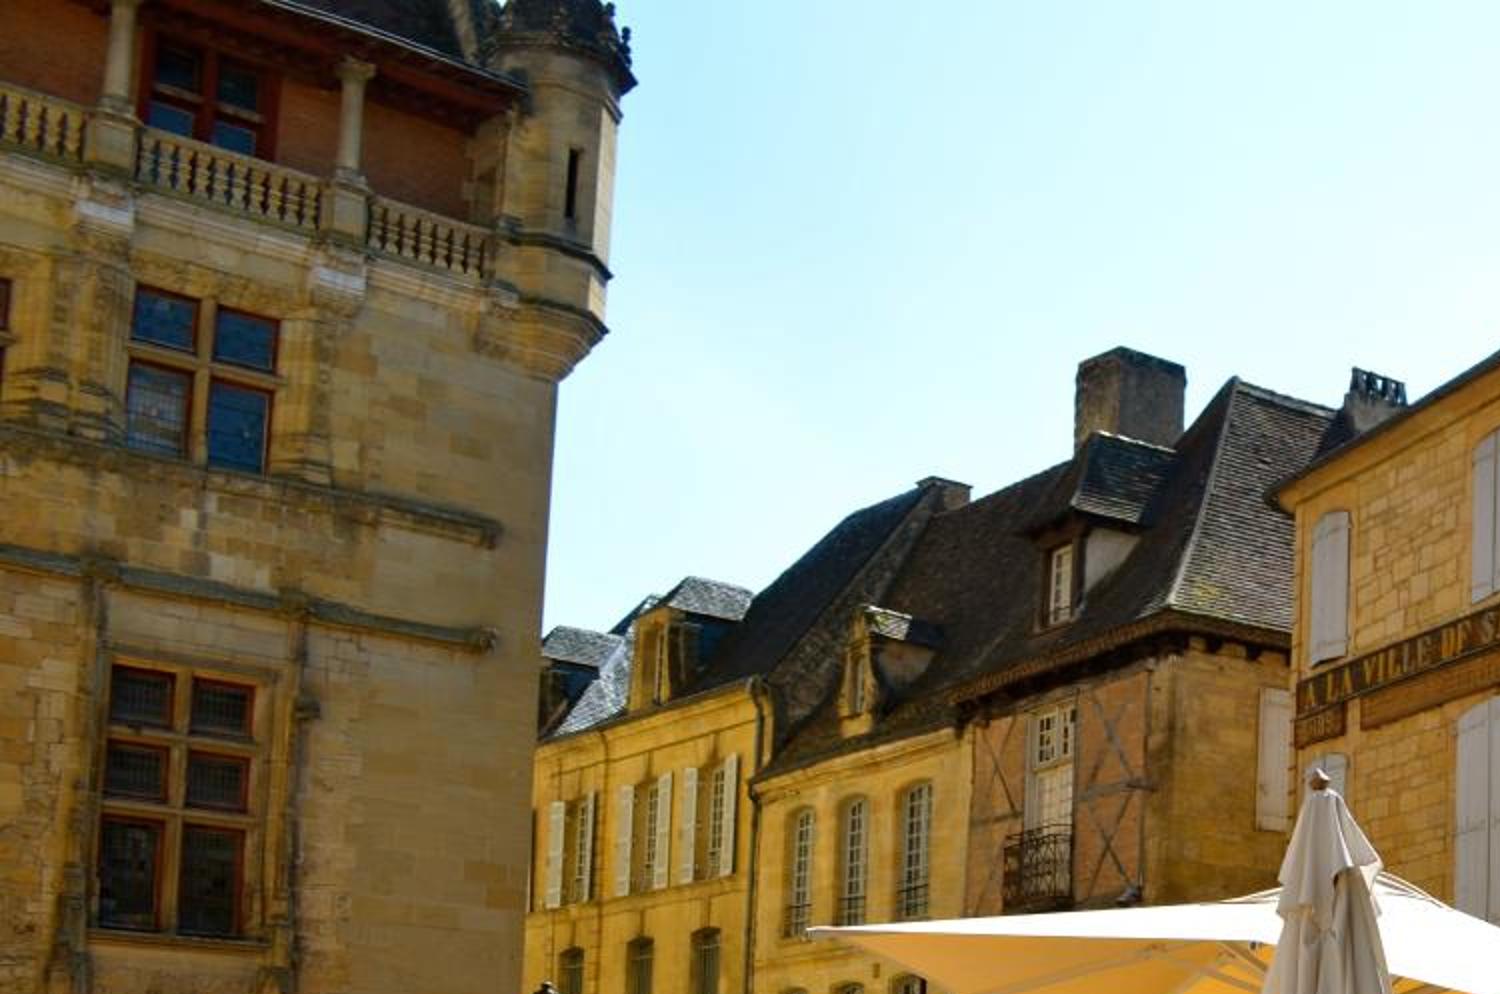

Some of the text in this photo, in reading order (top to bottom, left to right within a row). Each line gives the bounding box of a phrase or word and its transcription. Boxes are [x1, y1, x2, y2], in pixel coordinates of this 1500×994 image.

[1326, 663, 1353, 702] LA
[1363, 632, 1432, 688] VILLE
[1441, 617, 1472, 659] DE
